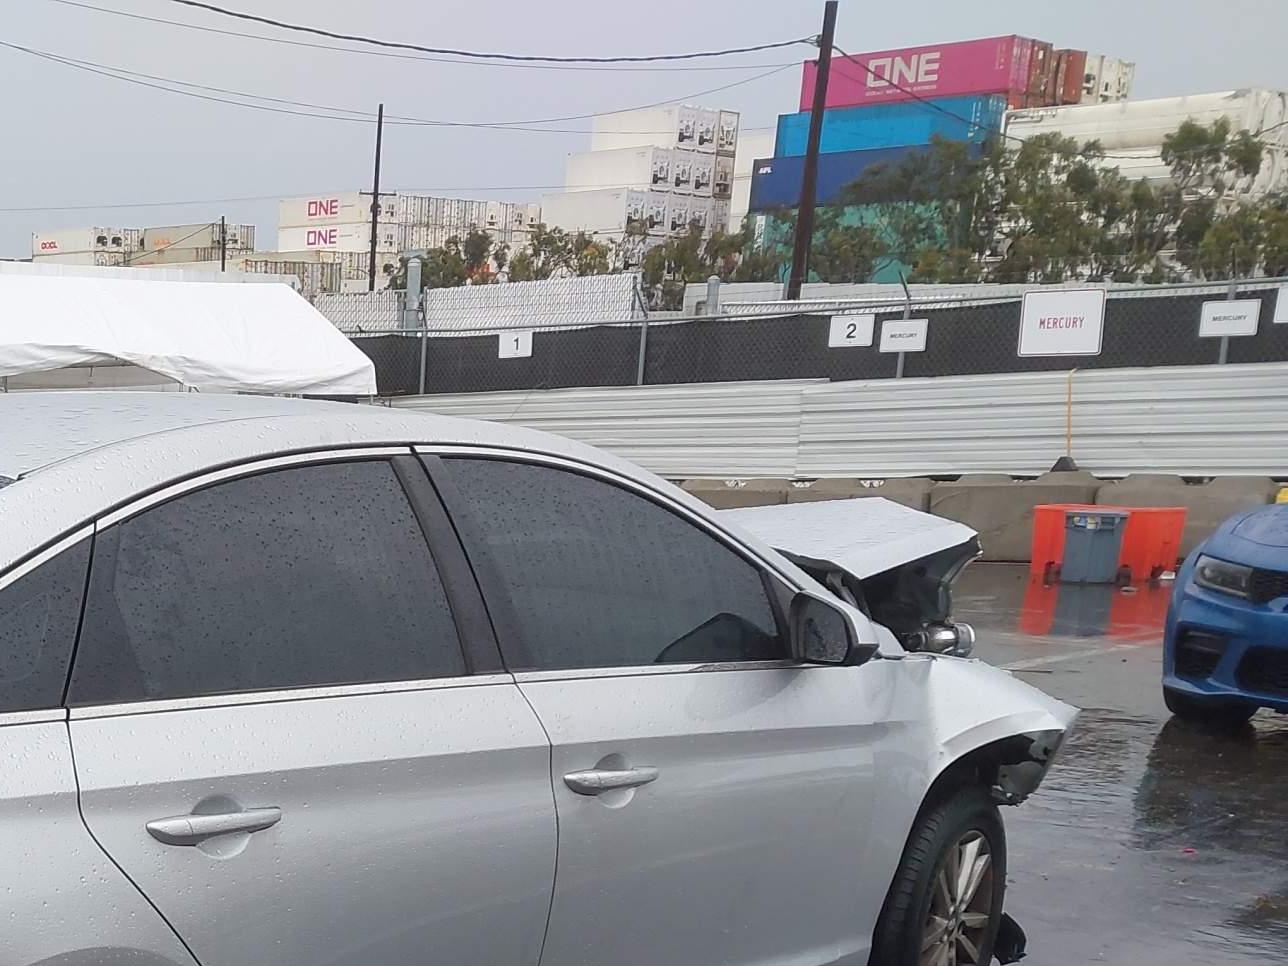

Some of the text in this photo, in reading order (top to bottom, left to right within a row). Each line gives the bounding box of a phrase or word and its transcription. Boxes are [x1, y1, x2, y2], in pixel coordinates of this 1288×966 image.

[866, 52, 940, 87] ONE
[307, 199, 338, 217] ONE
[306, 228, 337, 246] ONE
[1039, 316, 1085, 329] MERCURY
[1212, 314, 1248, 322] MERCURY
[846, 323, 857, 339] 2
[513, 337, 519, 351] 1
